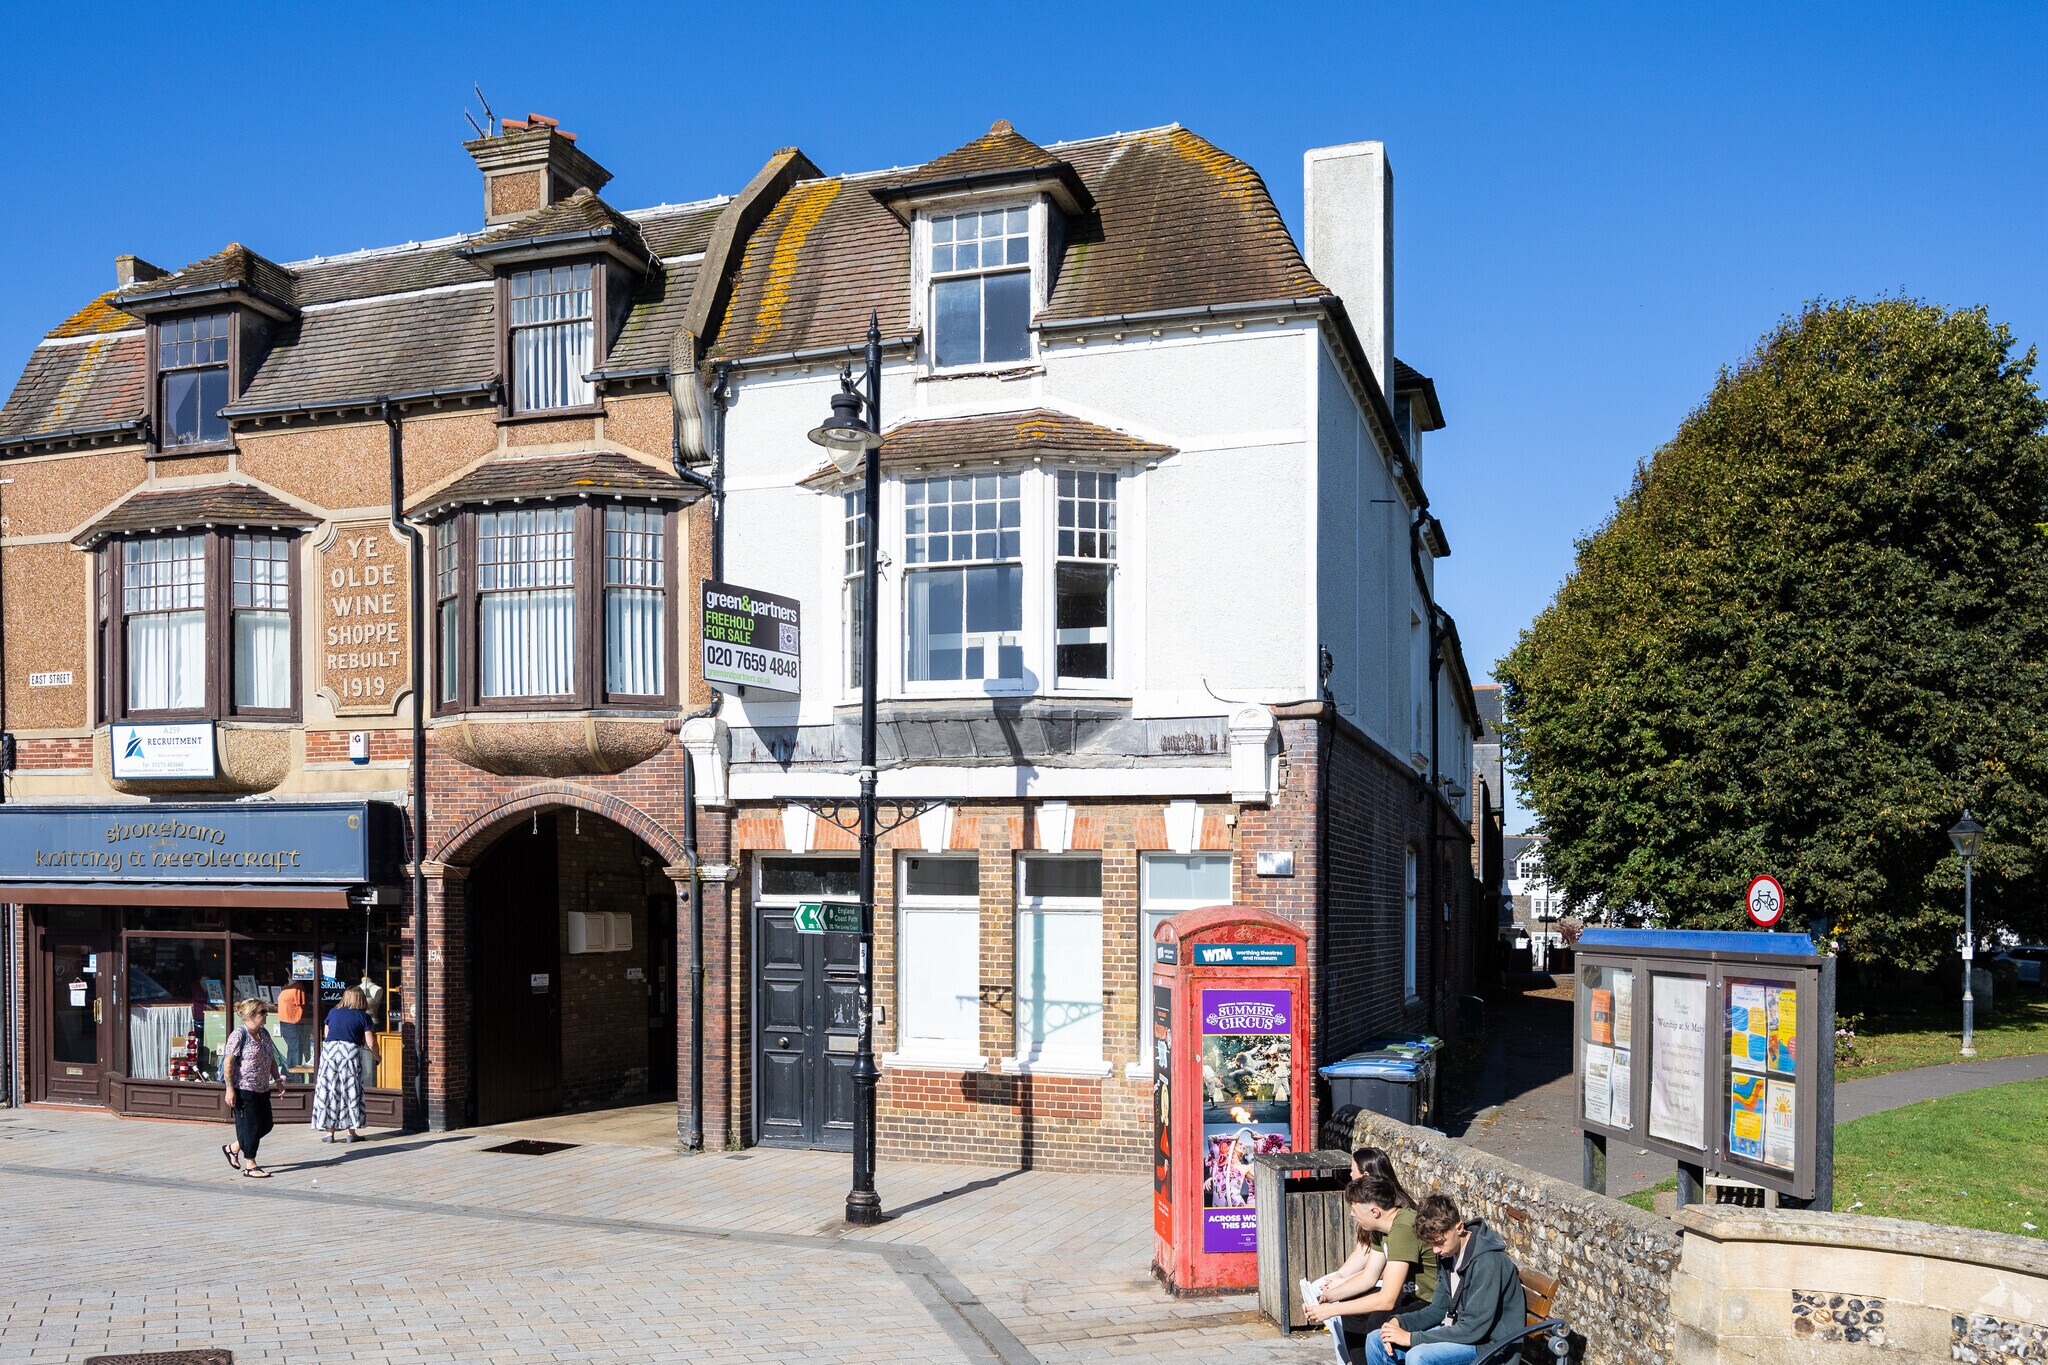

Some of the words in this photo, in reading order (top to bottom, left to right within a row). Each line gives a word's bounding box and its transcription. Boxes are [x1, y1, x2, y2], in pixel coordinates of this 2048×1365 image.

[347, 536, 379, 559] YE
[331, 564, 396, 588] OLDE
[332, 593, 396, 617] WINE
[706, 591, 797, 622] green&partners
[706, 611, 754, 631] FREEHOLD
[327, 622, 399, 646] SHOPPE
[706, 625, 725, 640] FOR
[728, 628, 751, 645] SALE
[327, 651, 400, 670] REBUILT
[707, 646, 732, 667] 020
[736, 650, 766, 673] 7659
[770, 657, 797, 679] 4848
[31, 674, 46, 685] EAST
[49, 673, 71, 684] STREET
[707, 668, 771, 685] greenandpartners.co.uk
[342, 676, 385, 698] 1919
[147, 737, 203, 746] RECRUITMENT
[105, 819, 226, 845] shoreham
[35, 849, 123, 872] knitting
[152, 849, 302, 872] needlecraft
[837, 907, 855, 916] England
[861, 949, 865, 957] 5
[320, 981, 346, 990] SIRDAR
[1218, 1005, 1274, 1017] SUMMER
[1218, 1017, 1274, 1030] CIRCUS
[1657, 1018, 1678, 1031] Worship
